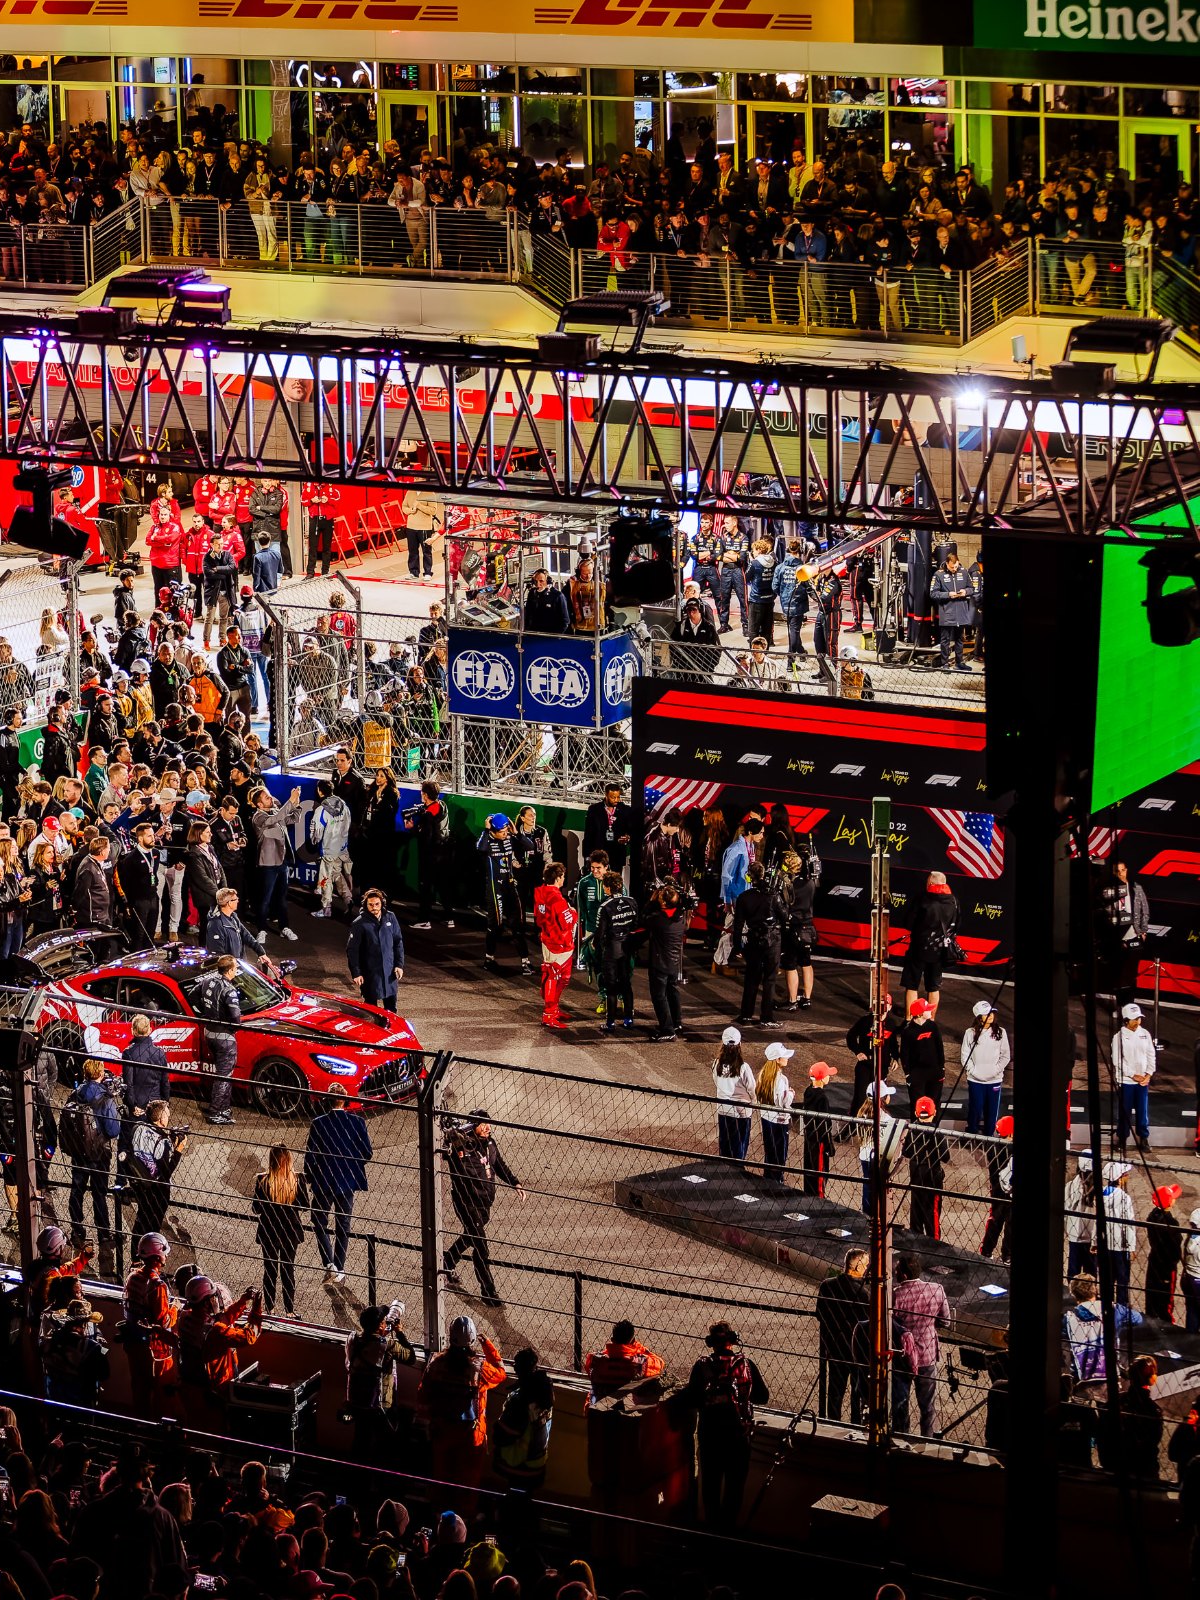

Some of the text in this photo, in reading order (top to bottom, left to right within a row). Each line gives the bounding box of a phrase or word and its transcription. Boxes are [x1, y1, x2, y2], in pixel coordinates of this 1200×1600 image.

[1023, 0, 1200, 43] Heinek
[146, 473, 157, 483] 44
[646, 742, 681, 755] F1
[737, 753, 773, 766] F1
[829, 763, 866, 776] F1
[924, 774, 962, 787] F1
[1138, 798, 1177, 811] F1
[832, 814, 910, 853] Las Vas
[896, 823, 907, 831] 22
[827, 885, 864, 898] F1
[611, 910, 637, 921] PETRONAS
[51, 930, 102, 947] Series
[150, 1028, 196, 1043] F1
